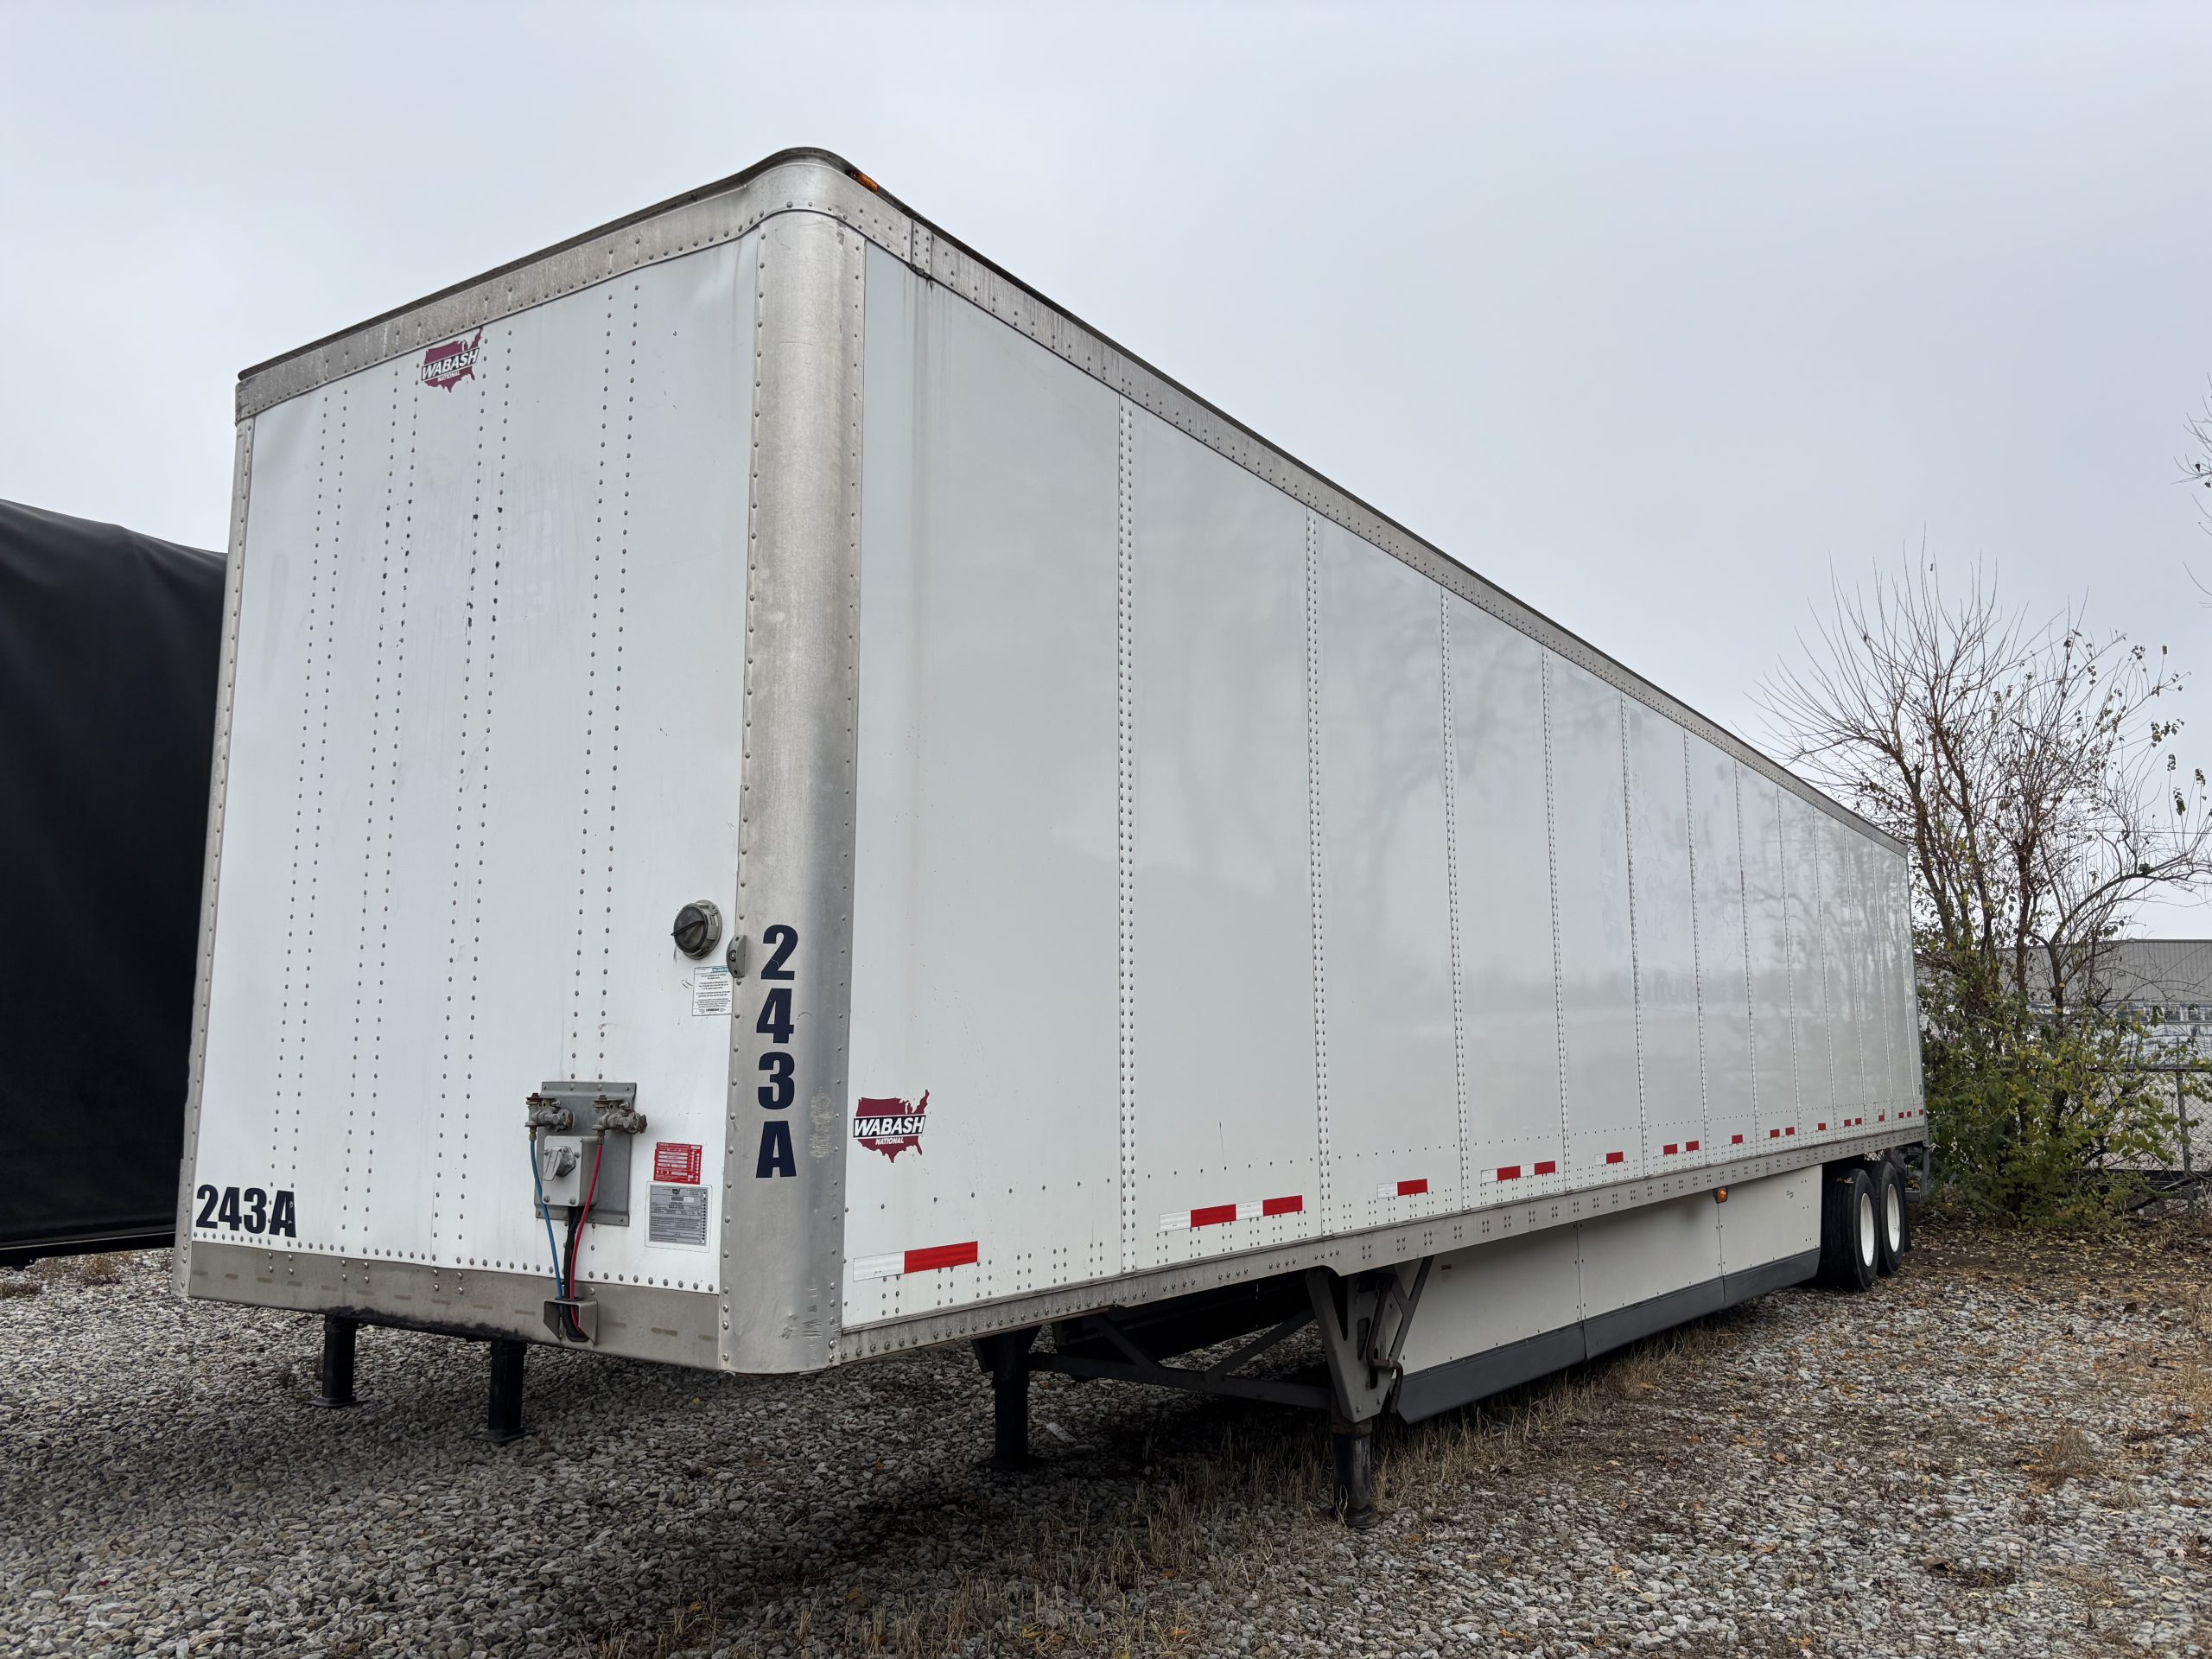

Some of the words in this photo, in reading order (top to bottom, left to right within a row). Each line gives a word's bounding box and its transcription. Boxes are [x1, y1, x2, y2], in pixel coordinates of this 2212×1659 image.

[422, 349, 479, 380] WABASH
[437, 370, 461, 382] NATIONAL
[755, 924, 798, 1179] 243A
[854, 1116, 925, 1137] WABASH
[875, 1137, 905, 1146] NATIONAL
[196, 1184, 297, 1238] 243A
